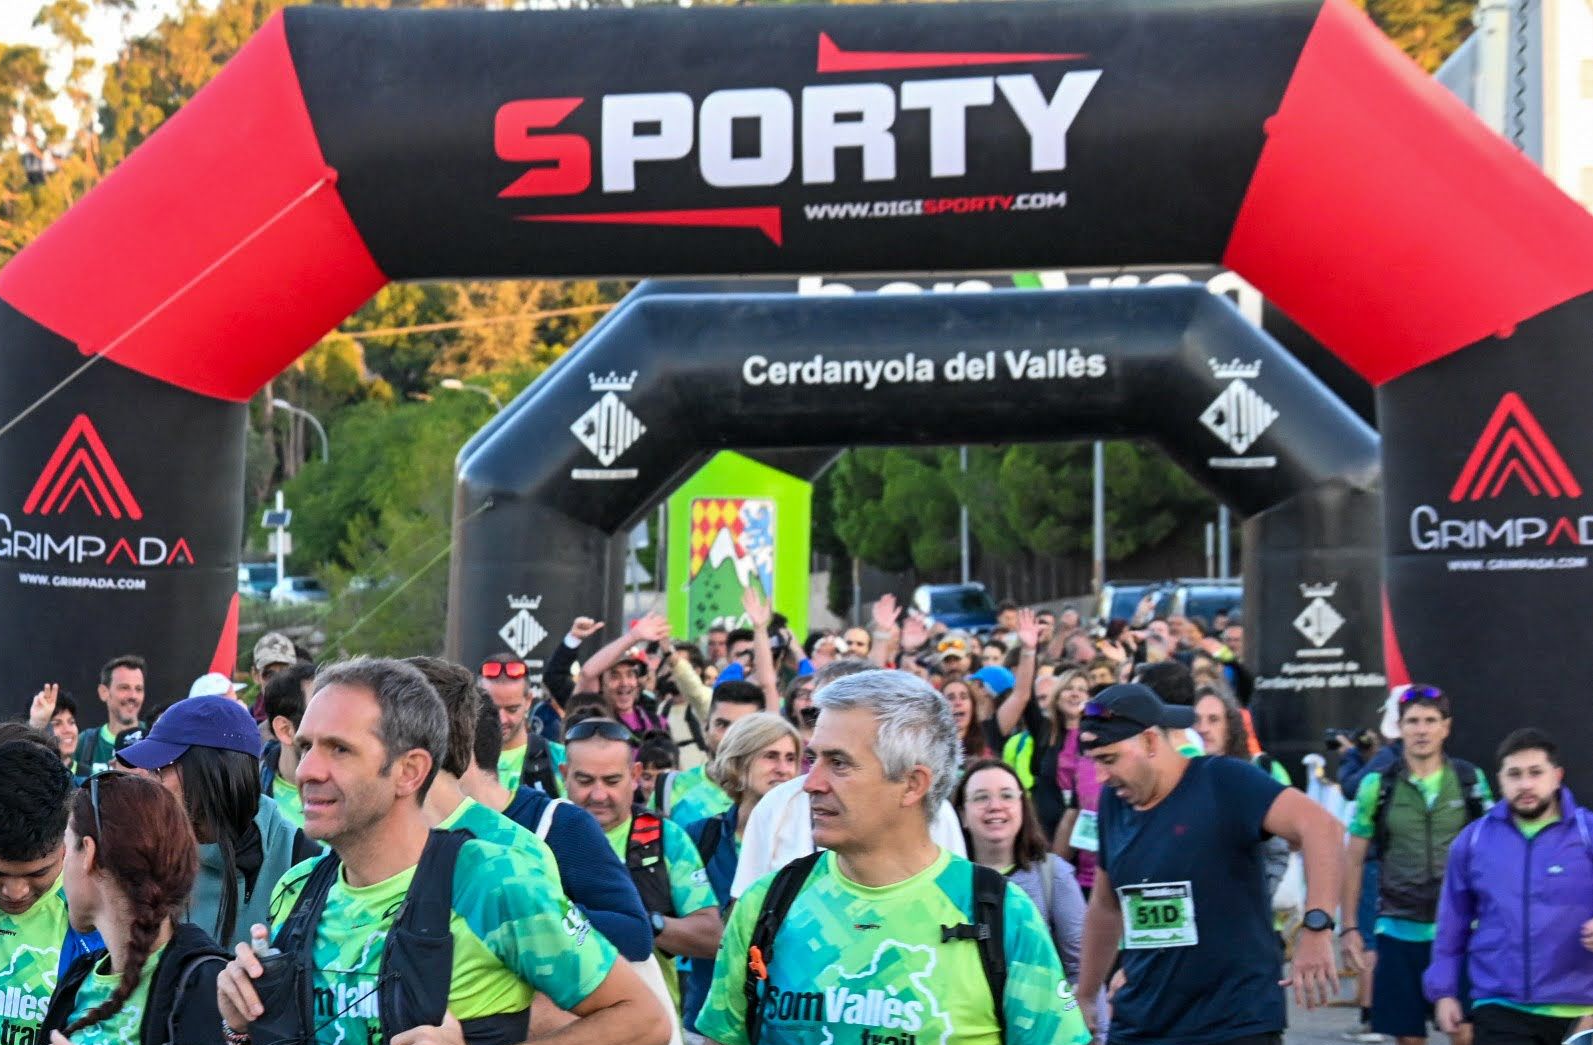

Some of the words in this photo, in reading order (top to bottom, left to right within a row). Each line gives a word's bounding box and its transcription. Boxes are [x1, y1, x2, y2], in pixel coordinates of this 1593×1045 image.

[494, 69, 1103, 197] SPORTY
[804, 191, 1067, 219] WWW.DIGISPORTY.COM
[743, 354, 934, 389] Cerdanyola
[944, 352, 995, 381] del
[1005, 349, 1107, 378] Vallès
[1136, 905, 1179, 925] 51D
